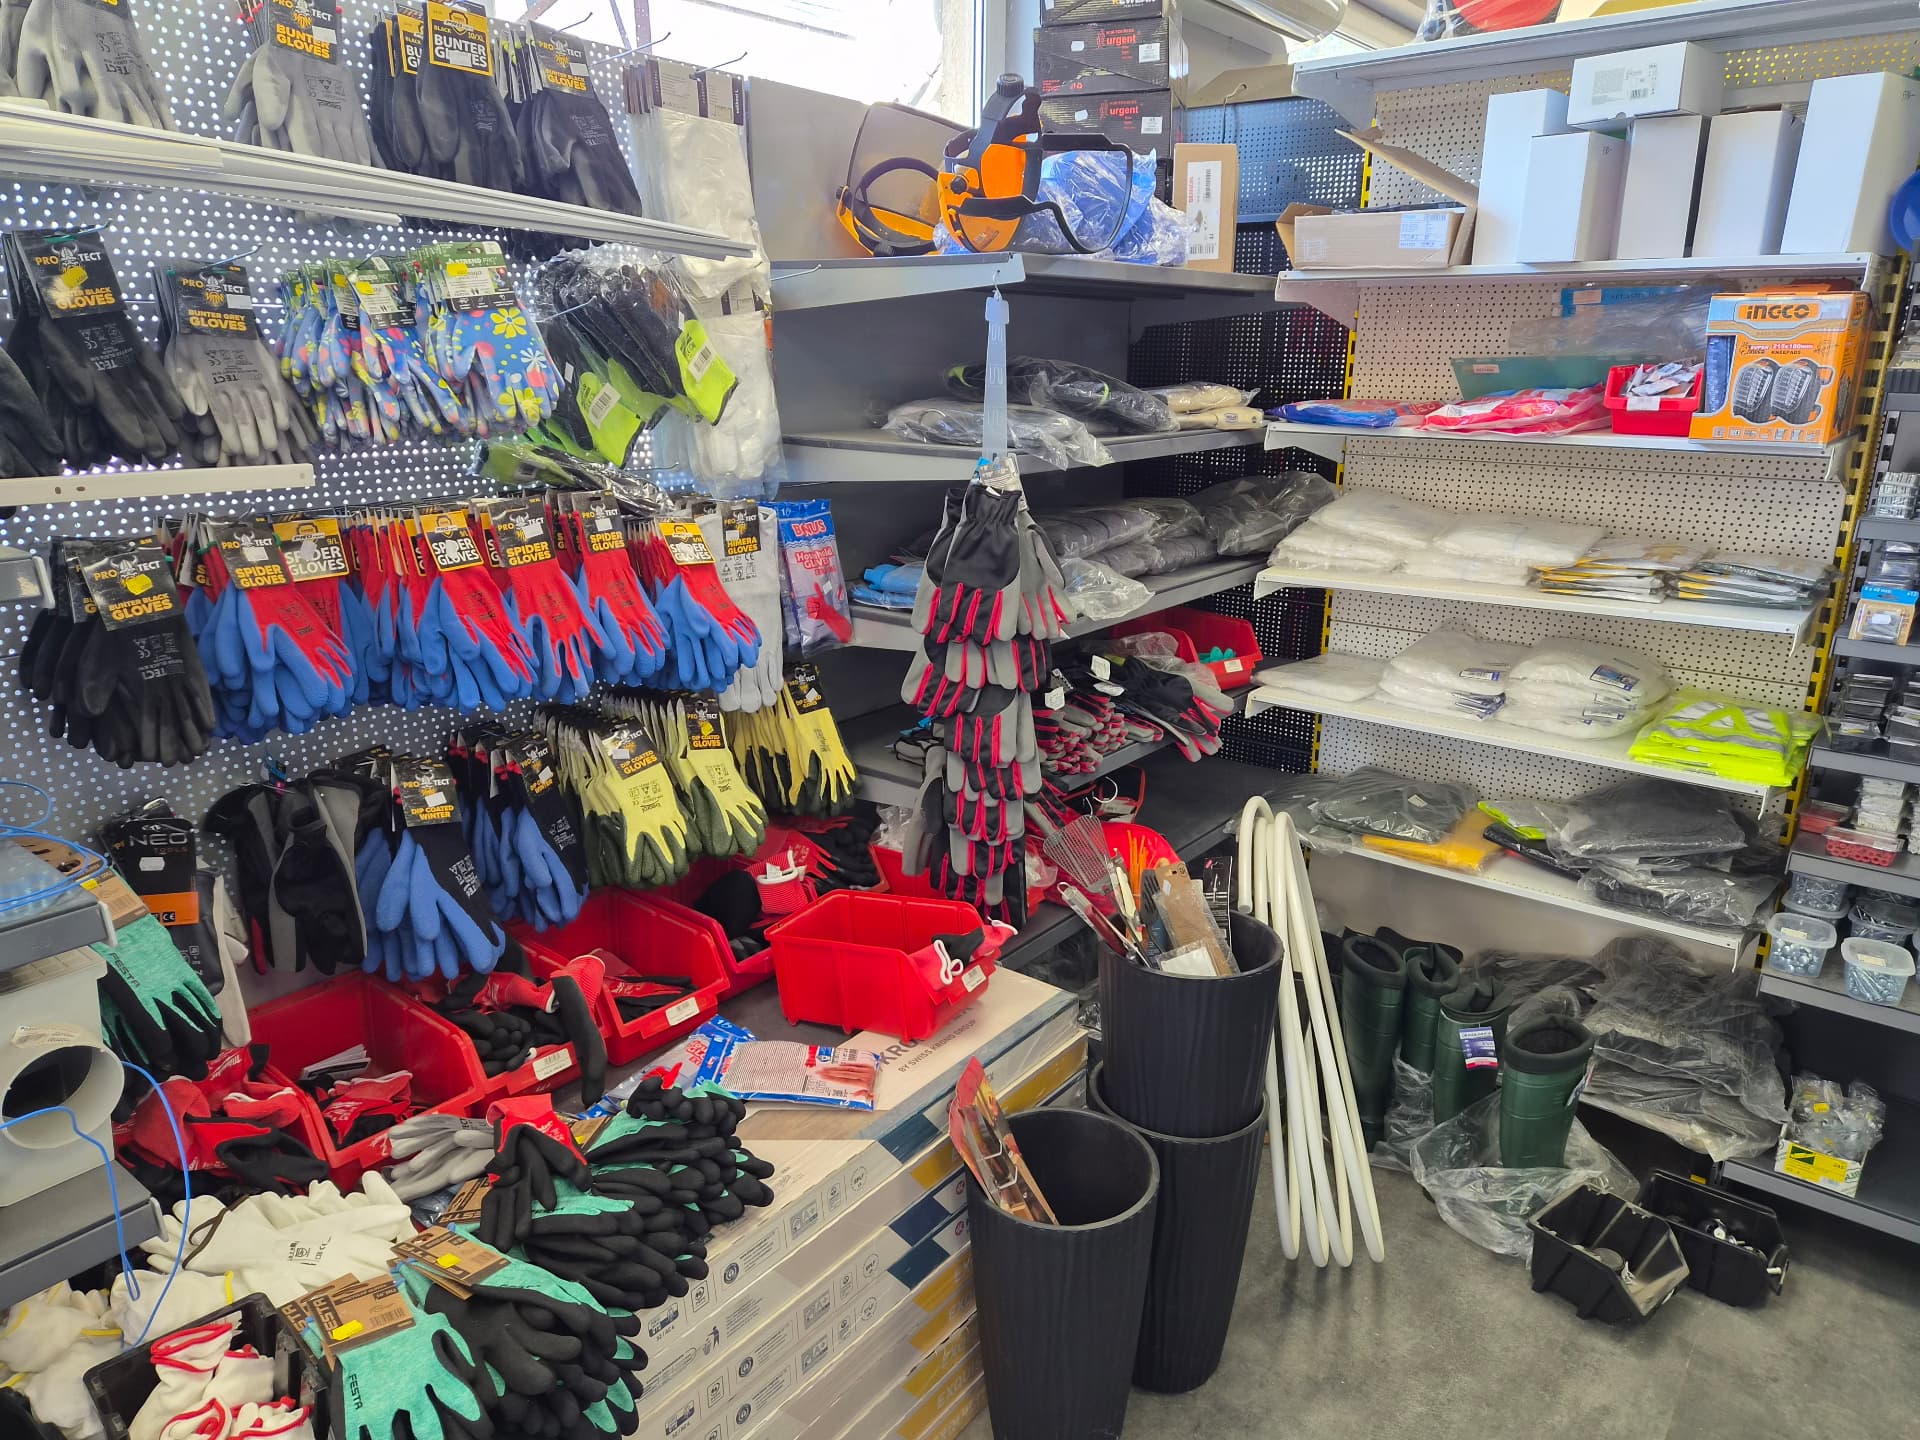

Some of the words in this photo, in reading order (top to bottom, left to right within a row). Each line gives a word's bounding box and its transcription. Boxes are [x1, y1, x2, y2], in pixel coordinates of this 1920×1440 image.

[311, 8, 332, 21] TECT
[433, 25, 452, 34] BLACK
[276, 34, 330, 59] GLOVES
[434, 34, 486, 56] BUNTER
[1106, 34, 1136, 46] urgent
[434, 46, 487, 68] GLES
[547, 74, 586, 91] GLOVES
[1110, 106, 1139, 117] urgent
[35, 256, 59, 266] PRO
[78, 252, 101, 262] TECT
[84, 287, 112, 296] BLACK
[182, 278, 204, 288] PRO
[222, 284, 244, 294] TECT
[56, 293, 115, 309] GLOVES
[188, 309, 222, 318] BUNTER
[190, 317, 247, 331] GLOVES
[95, 359, 117, 371] TECT
[213, 374, 239, 384] TECT
[497, 522, 514, 531] PRO
[527, 517, 544, 525] TECT
[589, 531, 623, 543] SPIDER
[221, 541, 240, 550] PRO
[254, 539, 273, 547] TECT
[432, 538, 474, 555] SPDER
[506, 542, 549, 558] SPIDER
[592, 539, 625, 551] GLOVES
[728, 544, 758, 555] GLOVES
[285, 546, 342, 564] SPDER
[437, 550, 480, 566] GLOVES
[509, 551, 551, 566] GLOVES
[93, 570, 118, 581] PRO
[137, 561, 160, 572] TECT
[235, 564, 282, 578] SPIDER
[289, 558, 345, 575] GLOVES
[240, 574, 286, 588] GLOVES
[109, 599, 141, 611] BUNTER
[142, 593, 170, 603] BLACK
[111, 599, 173, 620] GLOVES
[141, 667, 167, 681] TECT
[693, 740, 720, 748] GLOVES
[621, 761, 631, 769] DIP
[632, 750, 654, 762] COATED
[623, 754, 657, 775] GLOVES
[426, 805, 454, 813] COATED
[419, 812, 451, 821] WINTER
[129, 833, 189, 847] NEO
[162, 913, 175, 921] CE
[111, 952, 141, 988] FESTA
[898, 1065, 909, 1073] BY
[908, 1048, 933, 1066] SWISS
[931, 1033, 956, 1052] KRONO
[955, 1019, 977, 1038] GROUP
[281, 1304, 307, 1333] STA
[348, 1373, 363, 1410] FESTA
